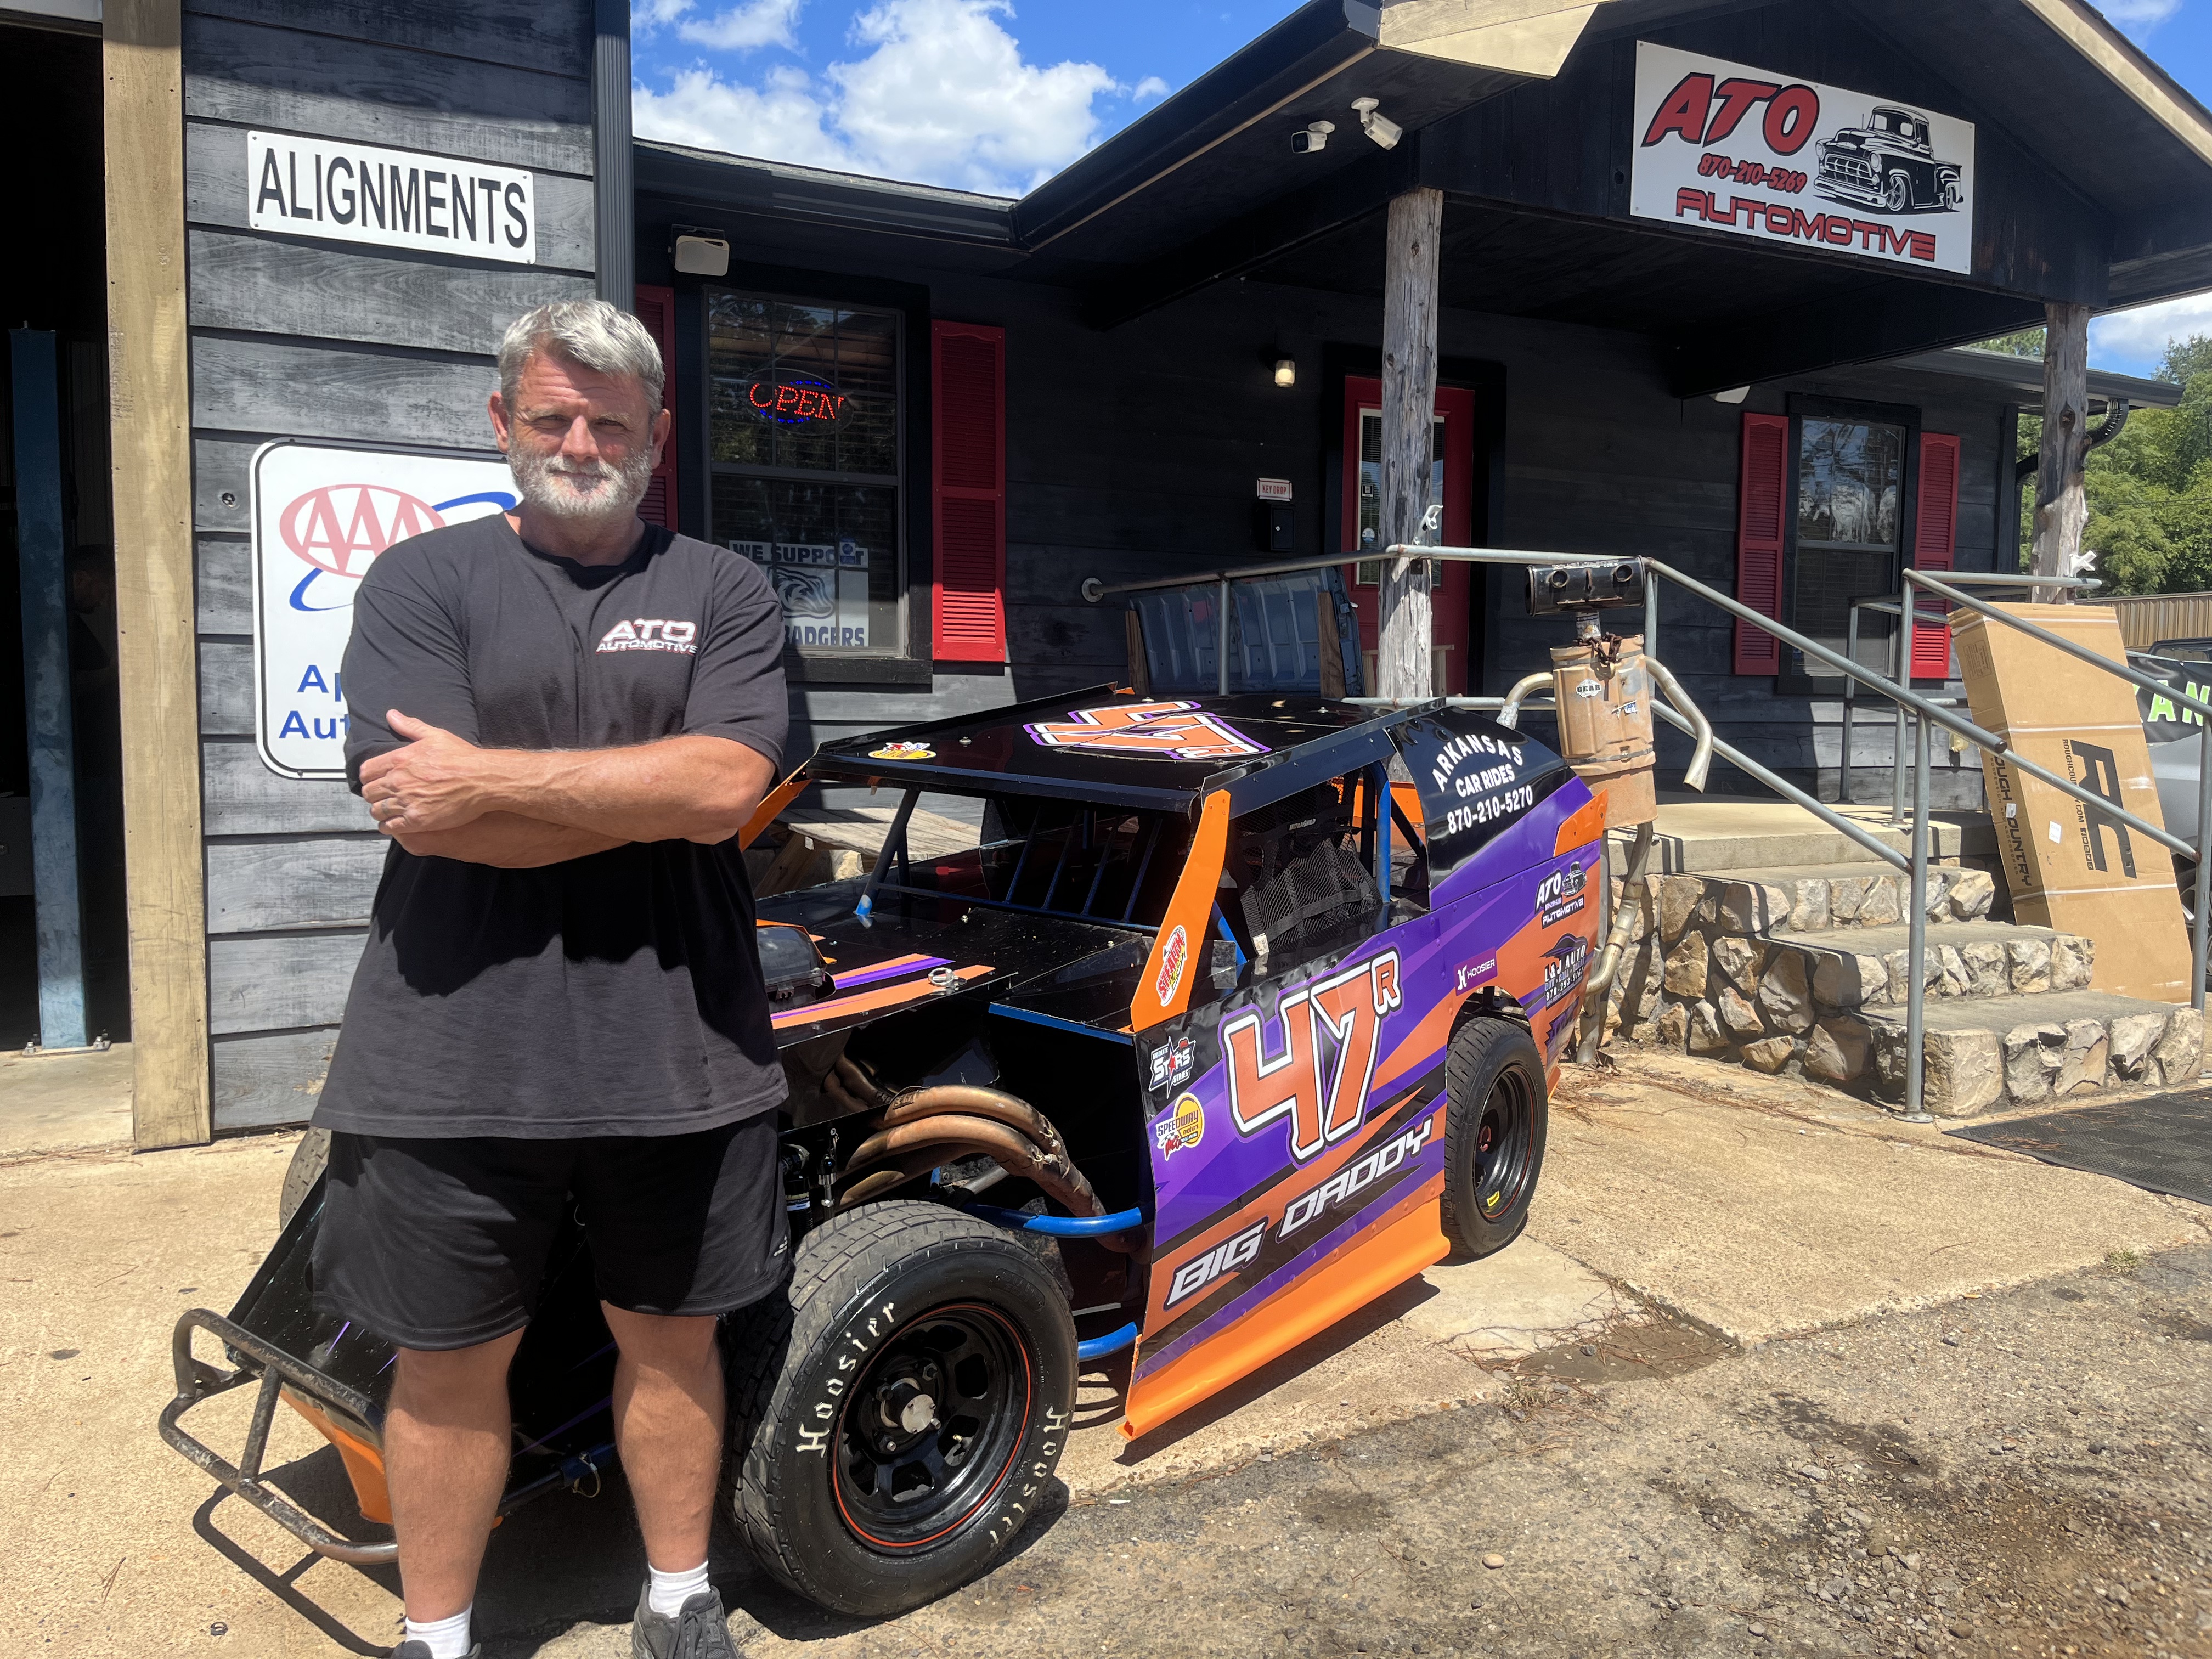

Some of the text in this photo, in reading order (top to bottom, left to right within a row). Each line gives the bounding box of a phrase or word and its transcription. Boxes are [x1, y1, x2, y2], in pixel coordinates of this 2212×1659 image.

[1640, 72, 1820, 156] ATO
[1699, 153, 1808, 194] 870-210-5269
[257, 148, 527, 248] ALIGNMENTS
[1676, 187, 1936, 262] AUTOMOTIVE
[1262, 484, 1286, 495] KEY DROP
[733, 544, 763, 560] WE
[771, 546, 864, 565] SUPPOT
[596, 639, 698, 654] AUTOMOTIVE
[601, 618, 697, 643] ATO
[1577, 684, 1600, 692] GEAR
[2132, 680, 2210, 726] AN
[1432, 735, 1523, 793] ARKANSAS
[1455, 763, 1515, 798] CAR RIDES
[2062, 738, 2085, 822] ROUGHCOUY.COM
[1447, 785, 1533, 834] 870-210-5270
[1994, 756, 2012, 800] OUGH
[2005, 806, 2032, 886] OUNTRY
[1536, 872, 1561, 911] ATO
[1542, 897, 1584, 926] AUTOMOTIVE
[1158, 930, 1185, 1001] STEALTH
[1467, 958, 1496, 979] HOOSIER
[1545, 944, 1585, 982] L&J AUTO
[1173, 1069, 1189, 1084] SERIES
[1158, 1109, 1199, 1137] SPEEDWAY
[1183, 1124, 1199, 1135] motors
[1166, 1119, 1432, 1306] BIG DADDY
